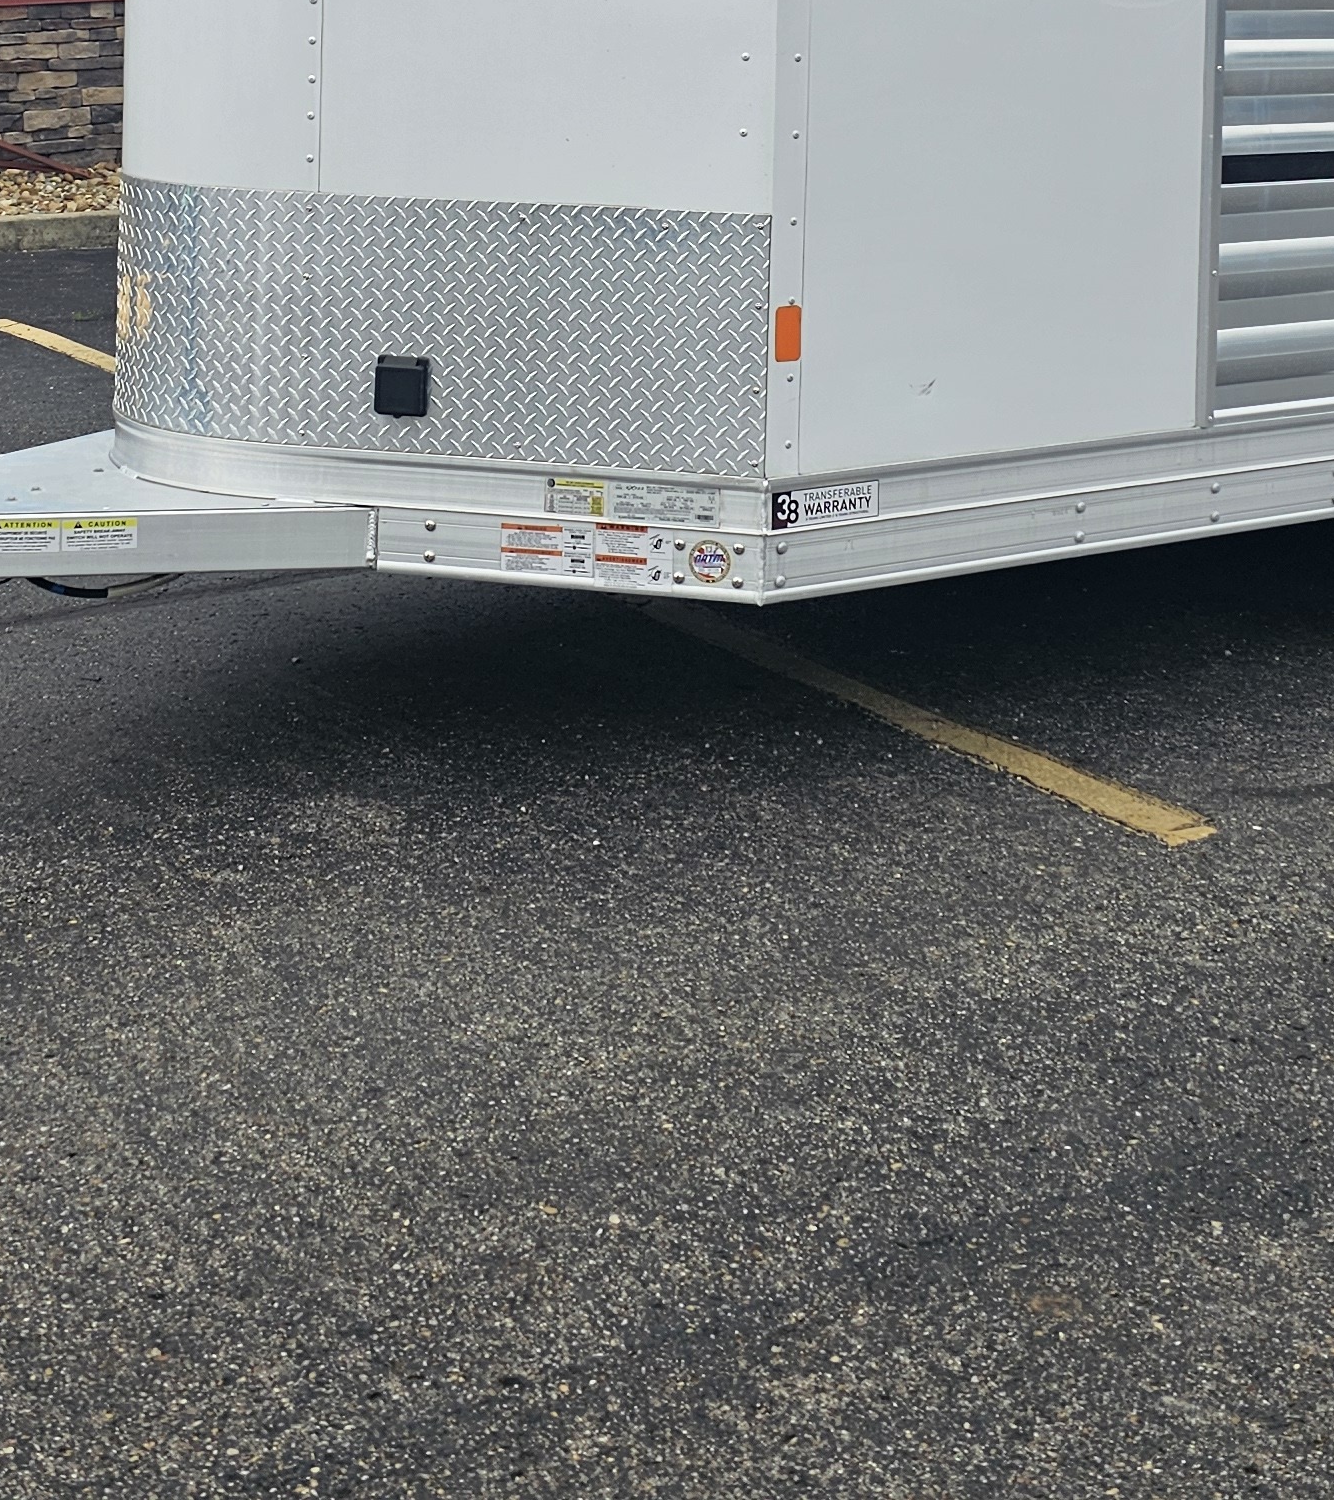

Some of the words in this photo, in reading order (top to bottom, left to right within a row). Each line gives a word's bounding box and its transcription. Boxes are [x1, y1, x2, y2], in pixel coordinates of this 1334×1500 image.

[803, 485, 872, 502] TRANSFERABLE
[776, 494, 799, 524] 38
[803, 496, 872, 516] WARRANTY
